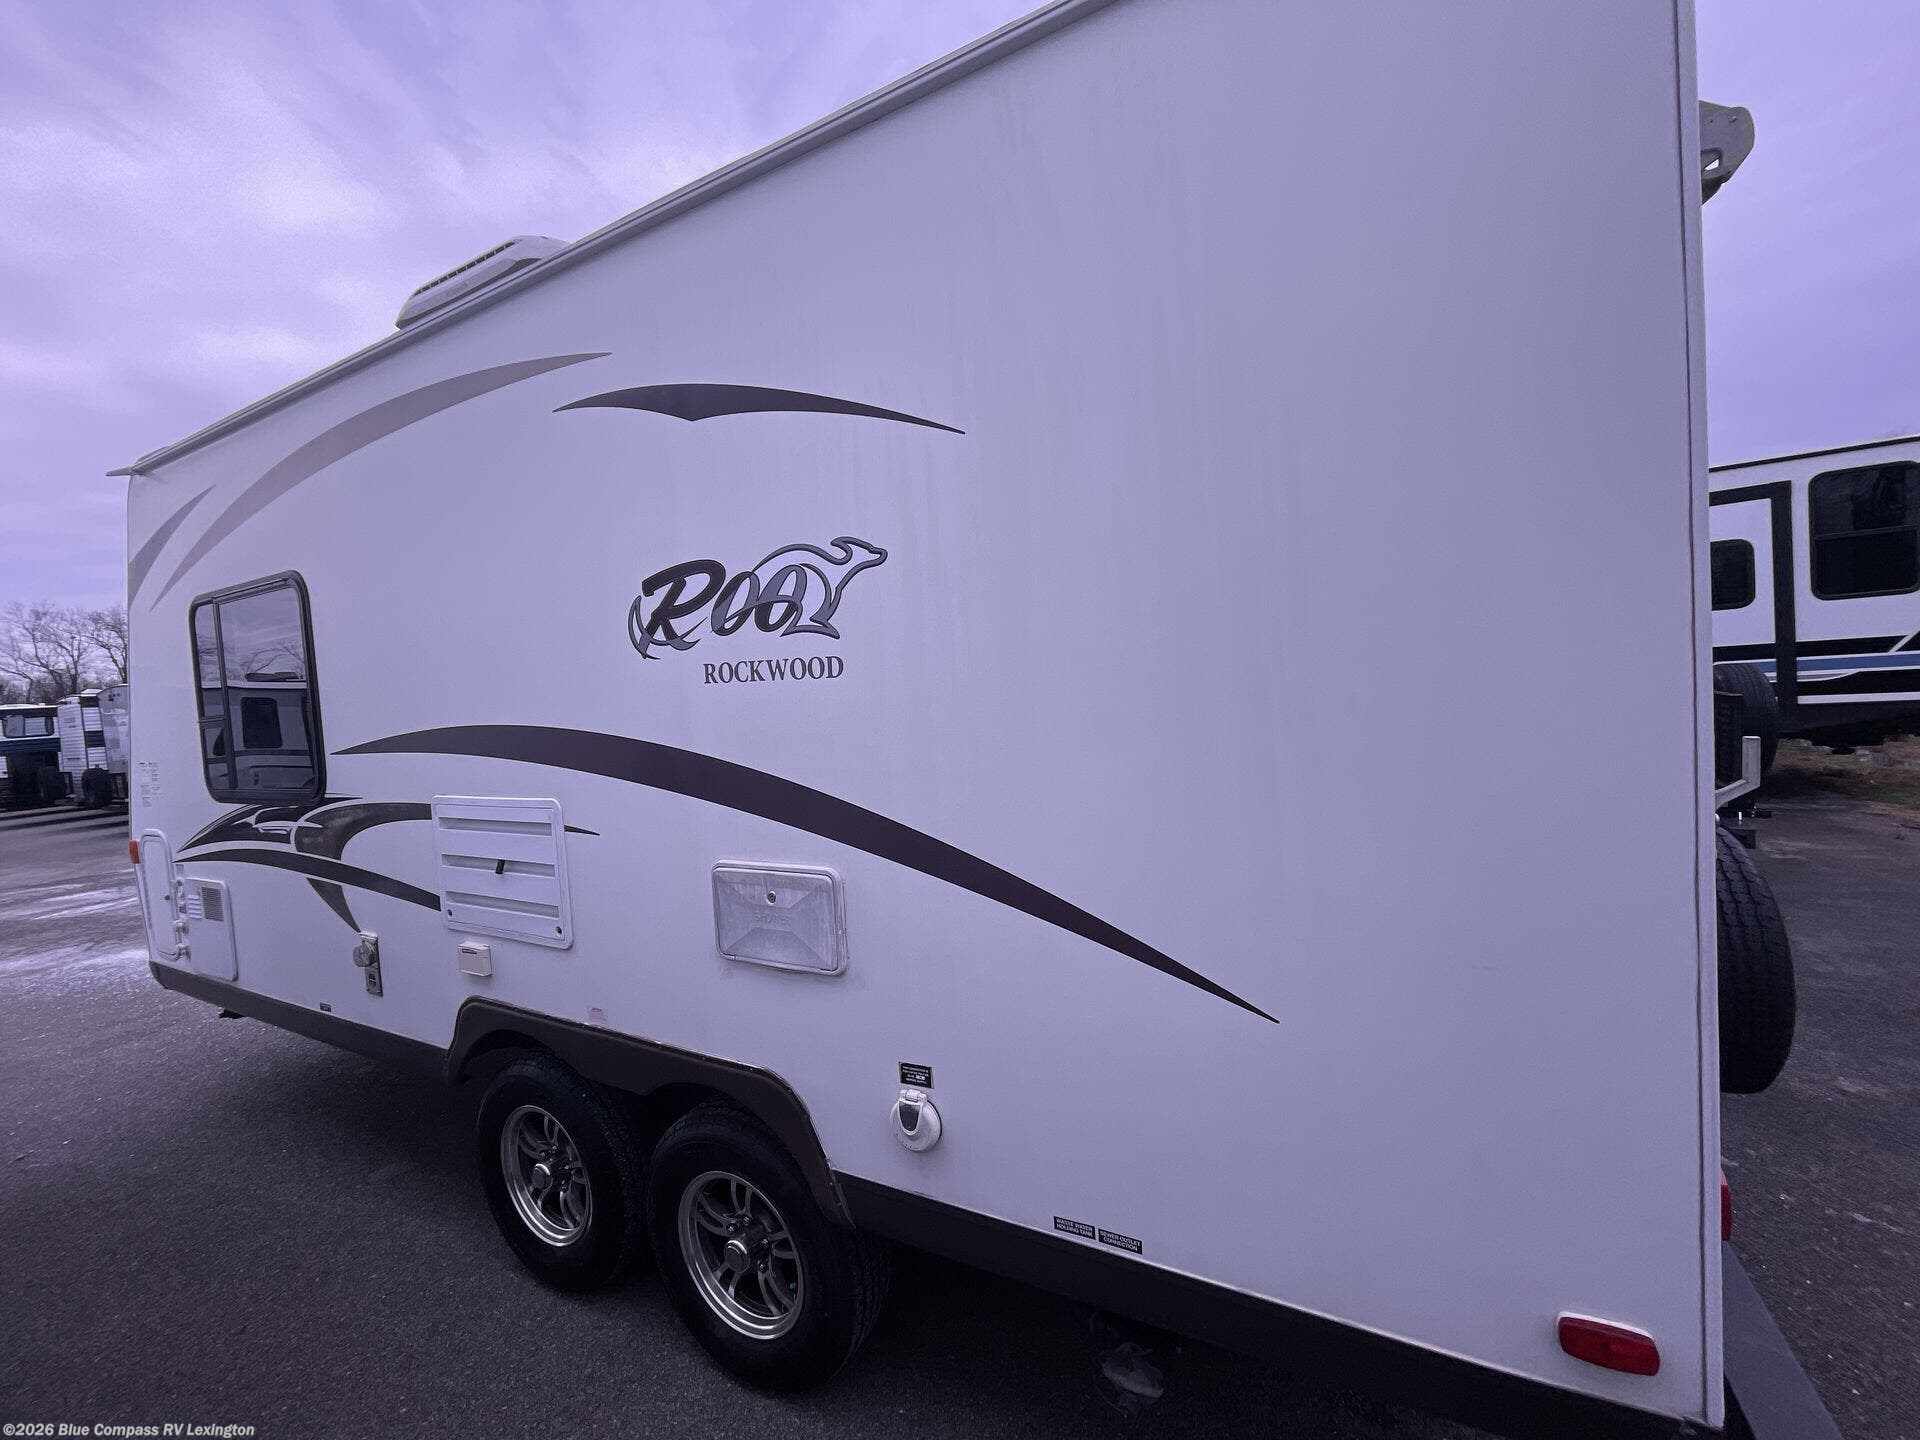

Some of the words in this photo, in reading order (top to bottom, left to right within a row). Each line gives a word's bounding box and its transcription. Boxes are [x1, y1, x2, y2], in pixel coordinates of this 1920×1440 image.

[703, 655, 844, 684] ROCKWOOD
[1056, 1217, 1074, 1227] WASTE
[1074, 1222, 1093, 1232] WATER
[1056, 1223, 1079, 1234] HOLDING
[1079, 1228, 1094, 1237] TANK
[1099, 1230, 1120, 1240] SEWER
[1119, 1237, 1141, 1247] OUTLET
[1104, 1237, 1138, 1251] CONNECTION
